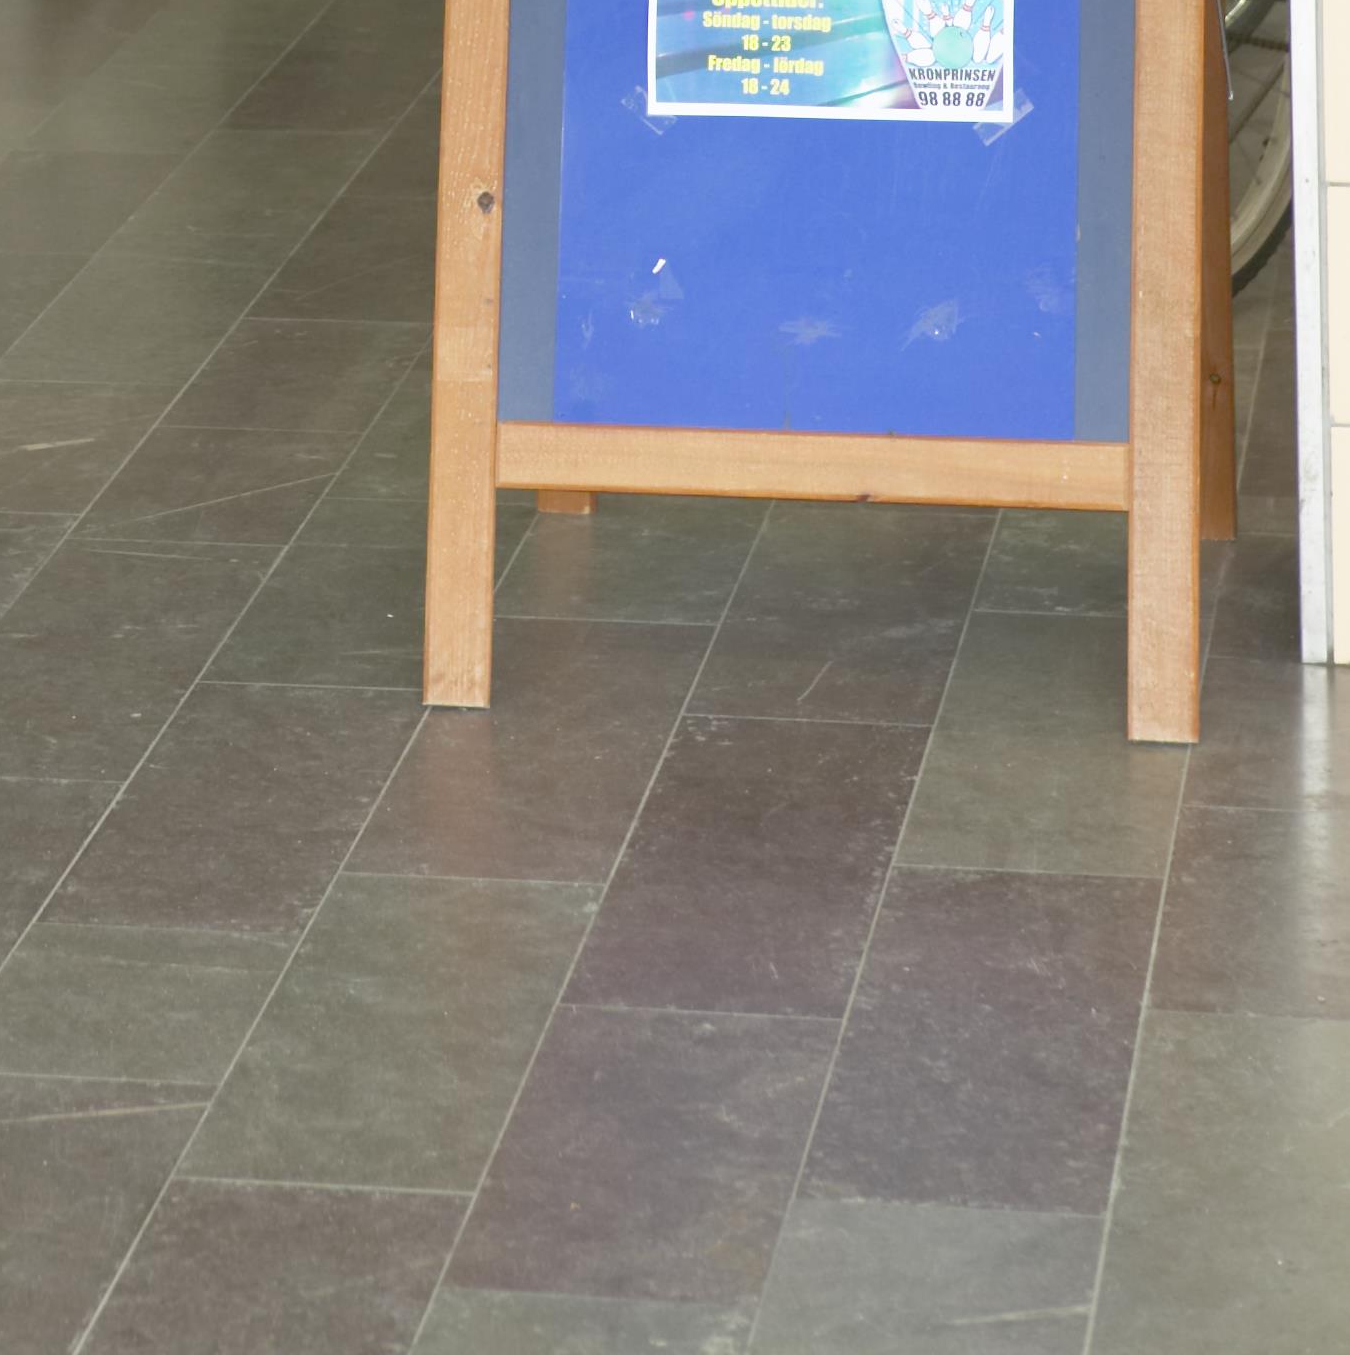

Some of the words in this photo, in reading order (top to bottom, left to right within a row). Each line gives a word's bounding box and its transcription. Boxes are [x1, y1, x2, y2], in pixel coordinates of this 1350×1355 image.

[702, 11, 760, 30] Söndag
[772, 14, 832, 32] torsdag
[708, 54, 761, 74] Fredag
[908, 68, 996, 81] KRONPRINSEN
[918, 91, 938, 106] 98
[942, 91, 961, 106] 88
[965, 92, 985, 107] 88
